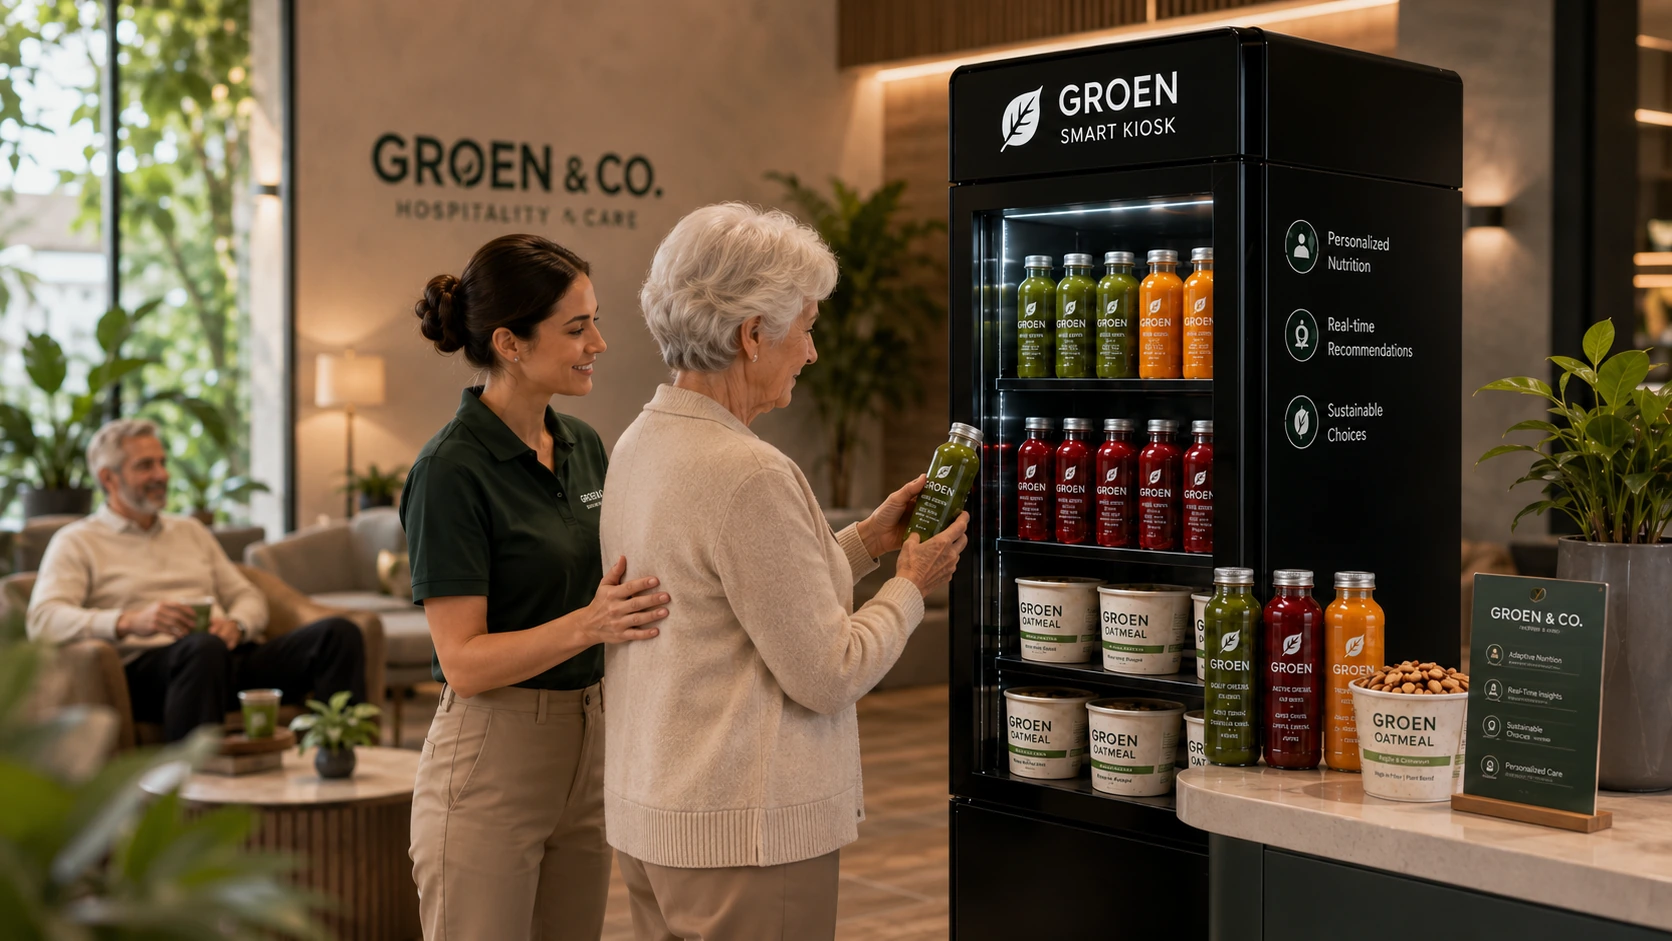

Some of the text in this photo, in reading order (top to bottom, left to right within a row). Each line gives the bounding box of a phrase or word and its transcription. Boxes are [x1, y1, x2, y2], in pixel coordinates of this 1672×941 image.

[1058, 71, 1178, 117] GROEN
[1060, 116, 1176, 145] SMART KIOSK
[371, 132, 664, 198] GROEN & CO.
[395, 199, 549, 226] HOSPITALITY
[582, 207, 638, 230] CARE
[1328, 231, 1390, 251] Personalized
[1328, 256, 1371, 272] Nutrition
[1017, 320, 1046, 329] GROEN
[1056, 319, 1086, 329] GROEN
[1097, 318, 1127, 328] GROEN
[1140, 318, 1171, 328] GROEN
[1328, 317, 1375, 333] Real-time
[1328, 341, 1413, 357] Recommendations
[1328, 402, 1383, 418] Sustainable
[1327, 427, 1367, 442] Choices
[1018, 482, 1046, 492] GROEN
[1056, 484, 1085, 493] GROEN
[1097, 486, 1127, 496] GROEN
[1140, 487, 1171, 498] GROEN
[1020, 602, 1062, 617] GROEN
[1490, 606, 1583, 627] GROEN & CO.
[1022, 617, 1061, 629] OATMEAL
[1102, 611, 1149, 627] GROEN
[1104, 626, 1147, 639] OATMEAL
[1210, 658, 1250, 671] GROEN
[1270, 661, 1312, 674] GROEN
[1333, 663, 1375, 676] GROEN
[1009, 715, 1052, 732] GROEN
[1373, 712, 1436, 731] GROEN
[1011, 730, 1051, 744] OATMEAL
[1092, 729, 1138, 747] GROEN
[1374, 732, 1434, 747] OATMEAL
[1093, 744, 1136, 760] OATMEAL
[1546, 768, 1563, 778] Care
